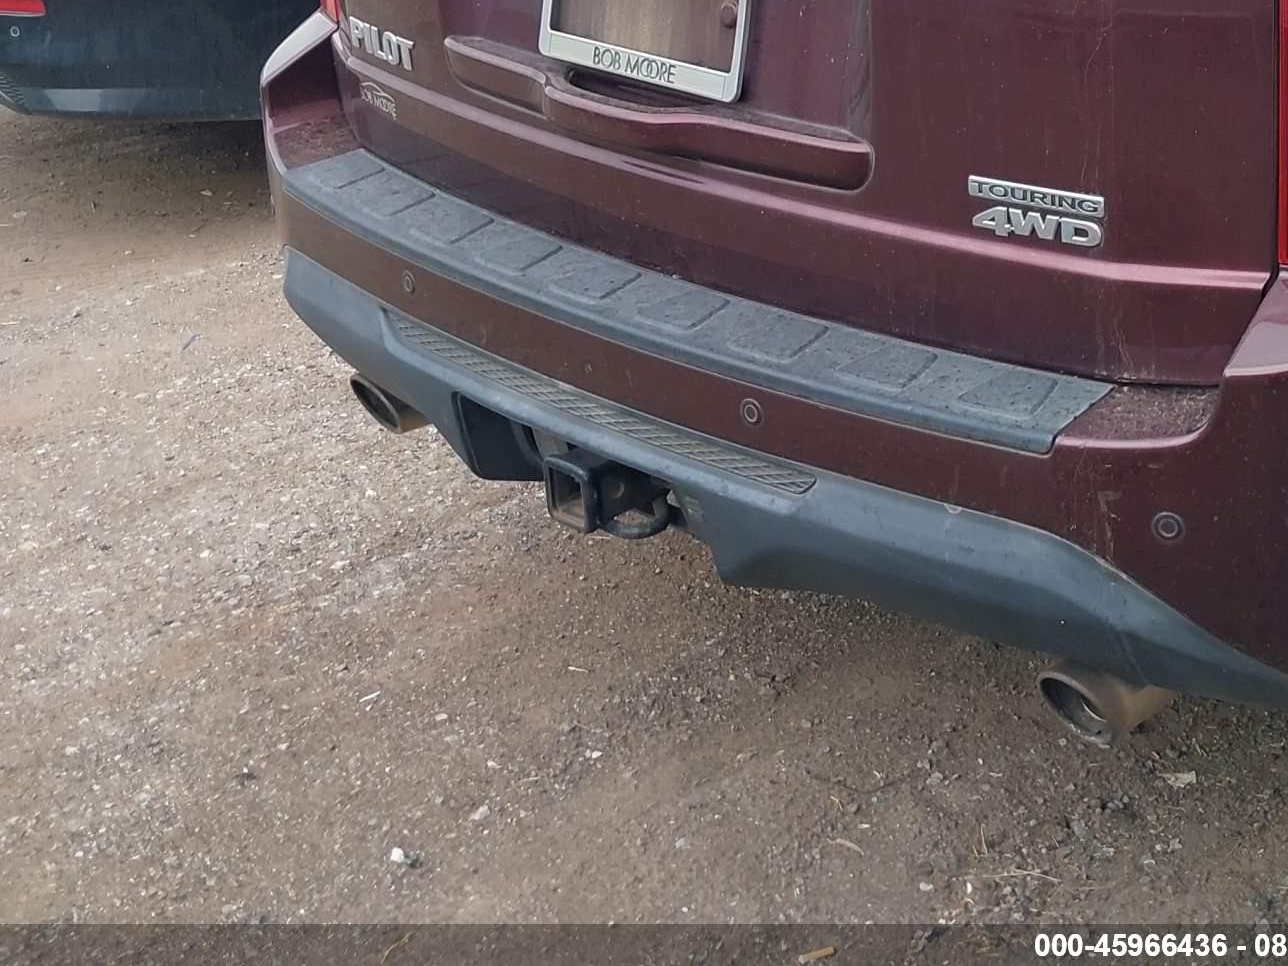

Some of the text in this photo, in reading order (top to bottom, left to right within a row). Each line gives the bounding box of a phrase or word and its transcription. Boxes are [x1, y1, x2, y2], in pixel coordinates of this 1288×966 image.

[349, 16, 415, 71] PILOT
[592, 46, 677, 84] BOB MOORE
[969, 178, 1101, 214] TOURING
[972, 205, 1102, 247] 4WD
